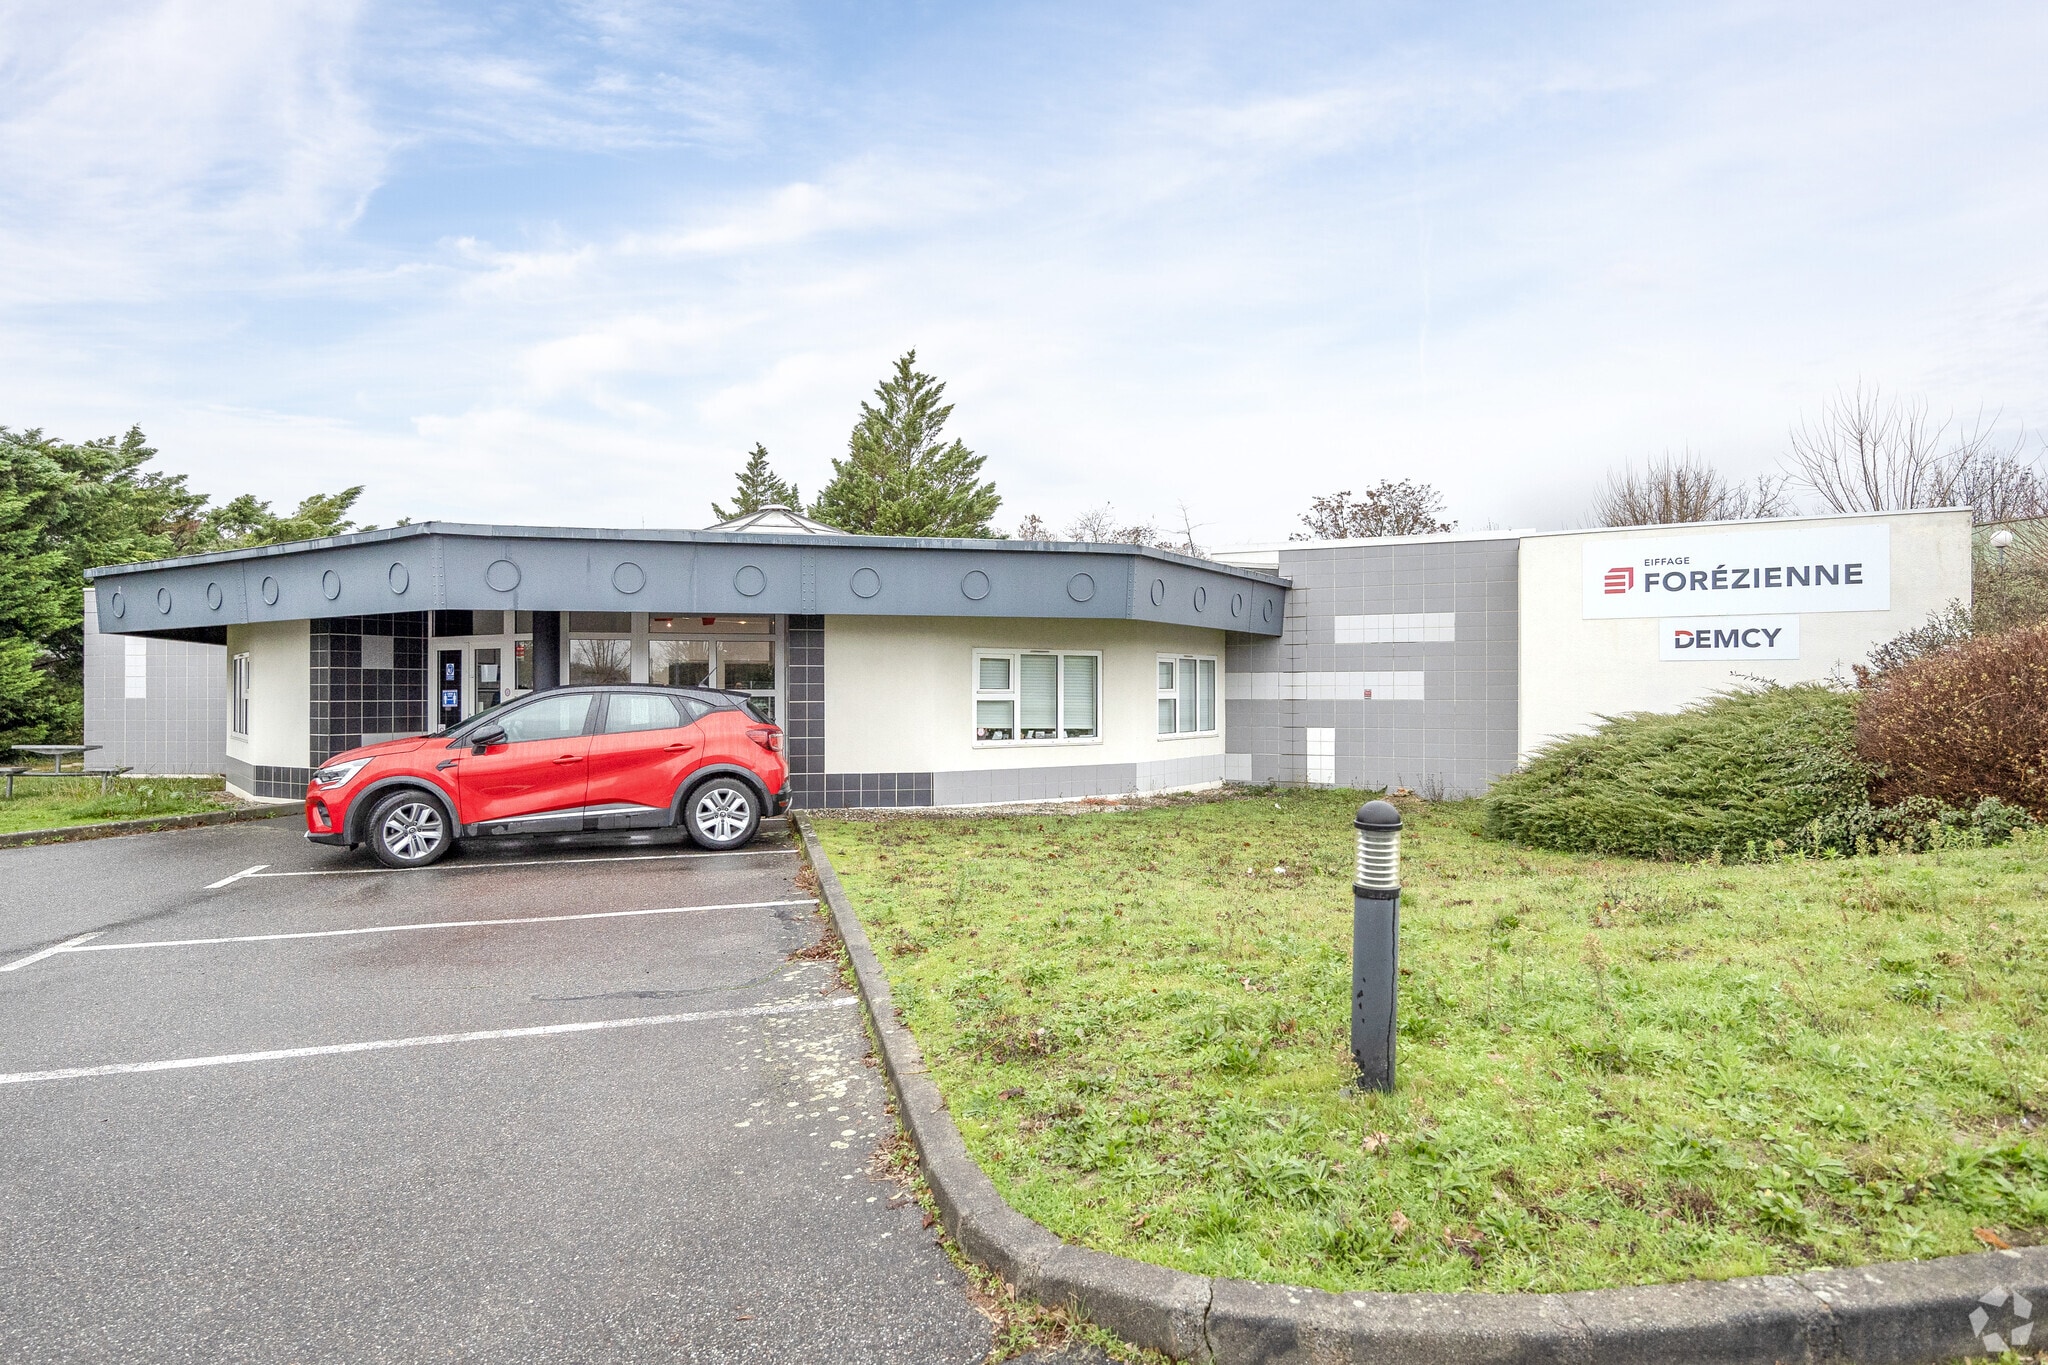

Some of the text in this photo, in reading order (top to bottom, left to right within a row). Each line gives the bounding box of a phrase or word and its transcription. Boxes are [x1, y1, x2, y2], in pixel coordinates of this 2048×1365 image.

[1644, 557, 1690, 566] EIFFAGE
[1645, 563, 1863, 592] FORÉZIENNE
[1674, 628, 1782, 649] DEMCY
